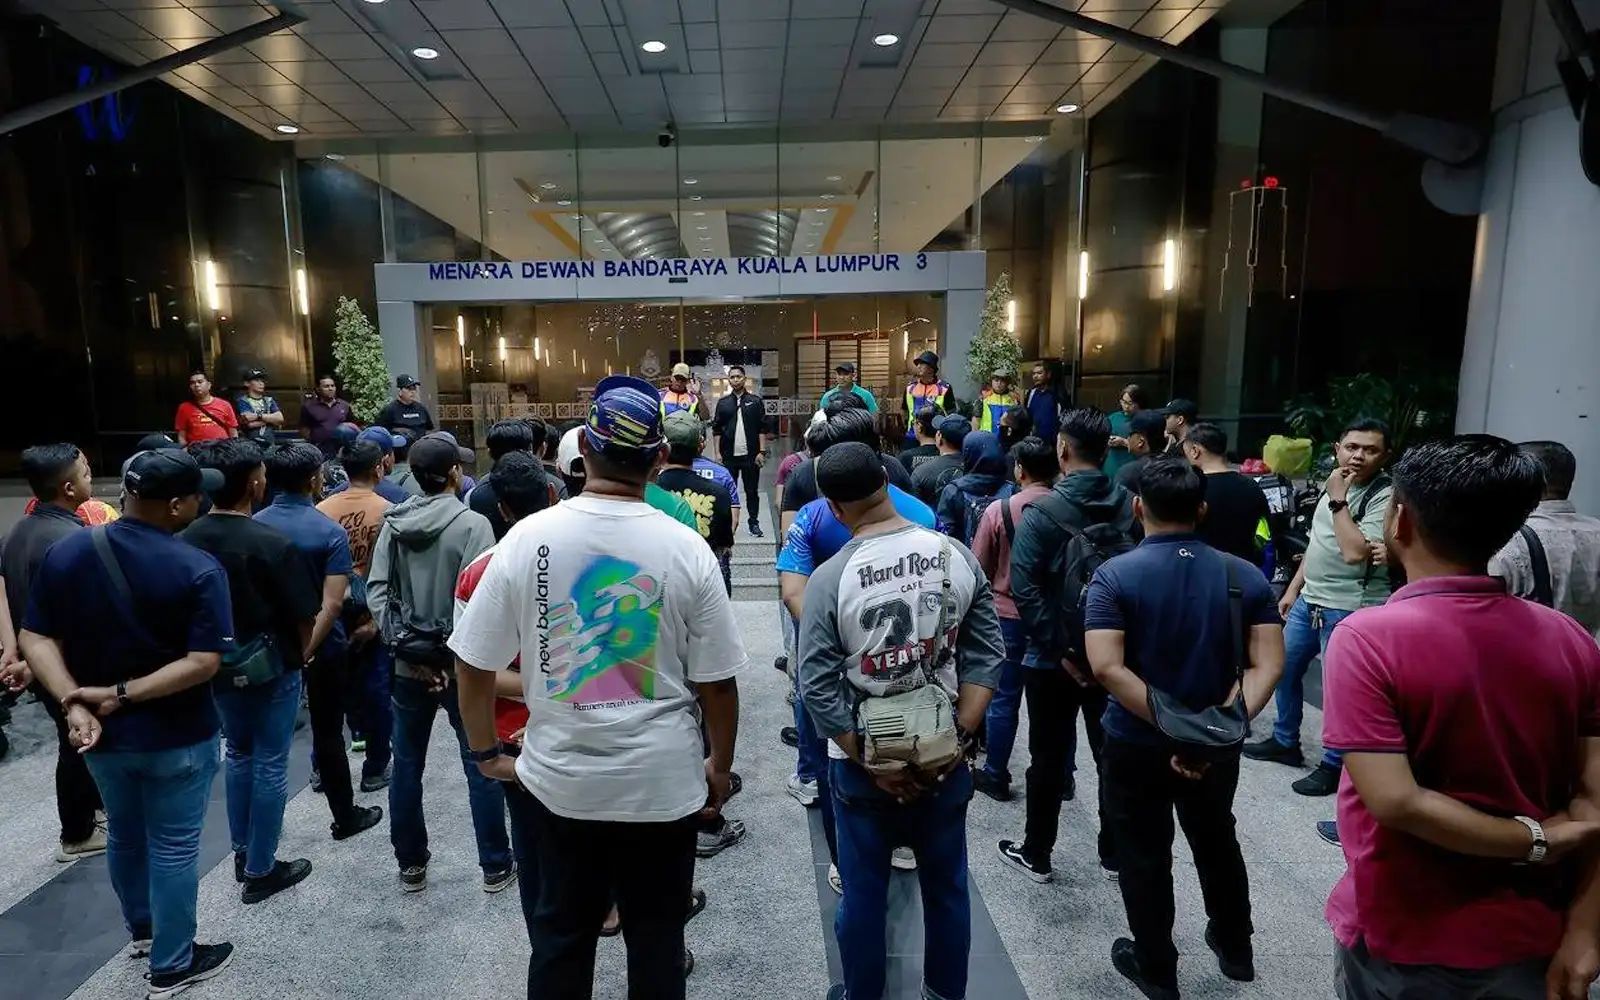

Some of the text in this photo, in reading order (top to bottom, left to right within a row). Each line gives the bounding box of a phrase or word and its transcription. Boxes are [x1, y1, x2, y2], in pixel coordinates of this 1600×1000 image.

[429, 253, 928, 280] MENARA DEWAN BANDARAYA KUALA LUMPUR 3
[857, 557, 905, 589] Hard
[900, 580, 923, 593] CAFE
[534, 544, 551, 675] new balance
